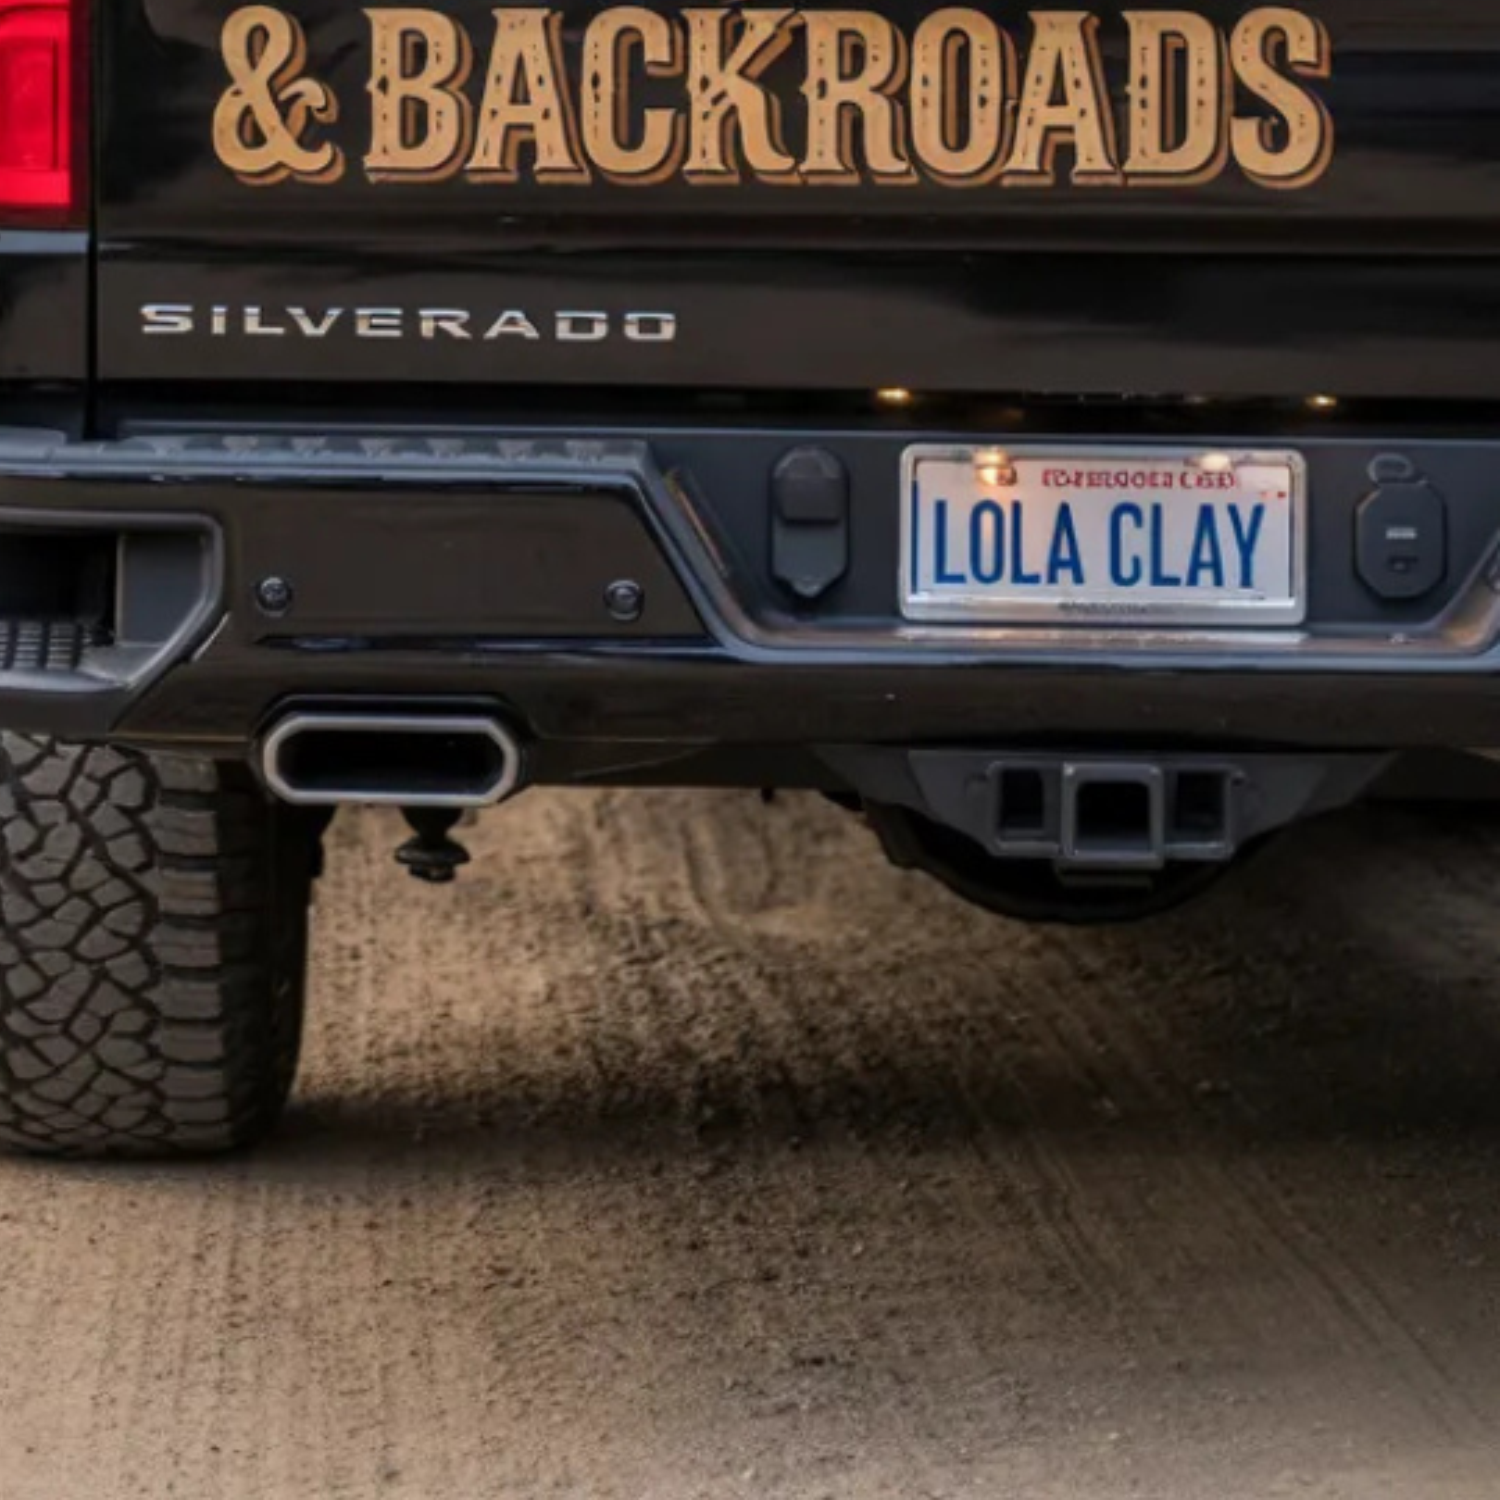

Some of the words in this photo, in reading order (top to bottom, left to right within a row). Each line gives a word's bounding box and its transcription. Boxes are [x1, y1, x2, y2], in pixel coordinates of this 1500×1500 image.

[211, 4, 345, 186] &
[362, 6, 1335, 190] BACKROADS
[139, 304, 677, 341] SILVERADO
[932, 499, 1084, 585] LOLA
[1108, 501, 1265, 588] CLAY
